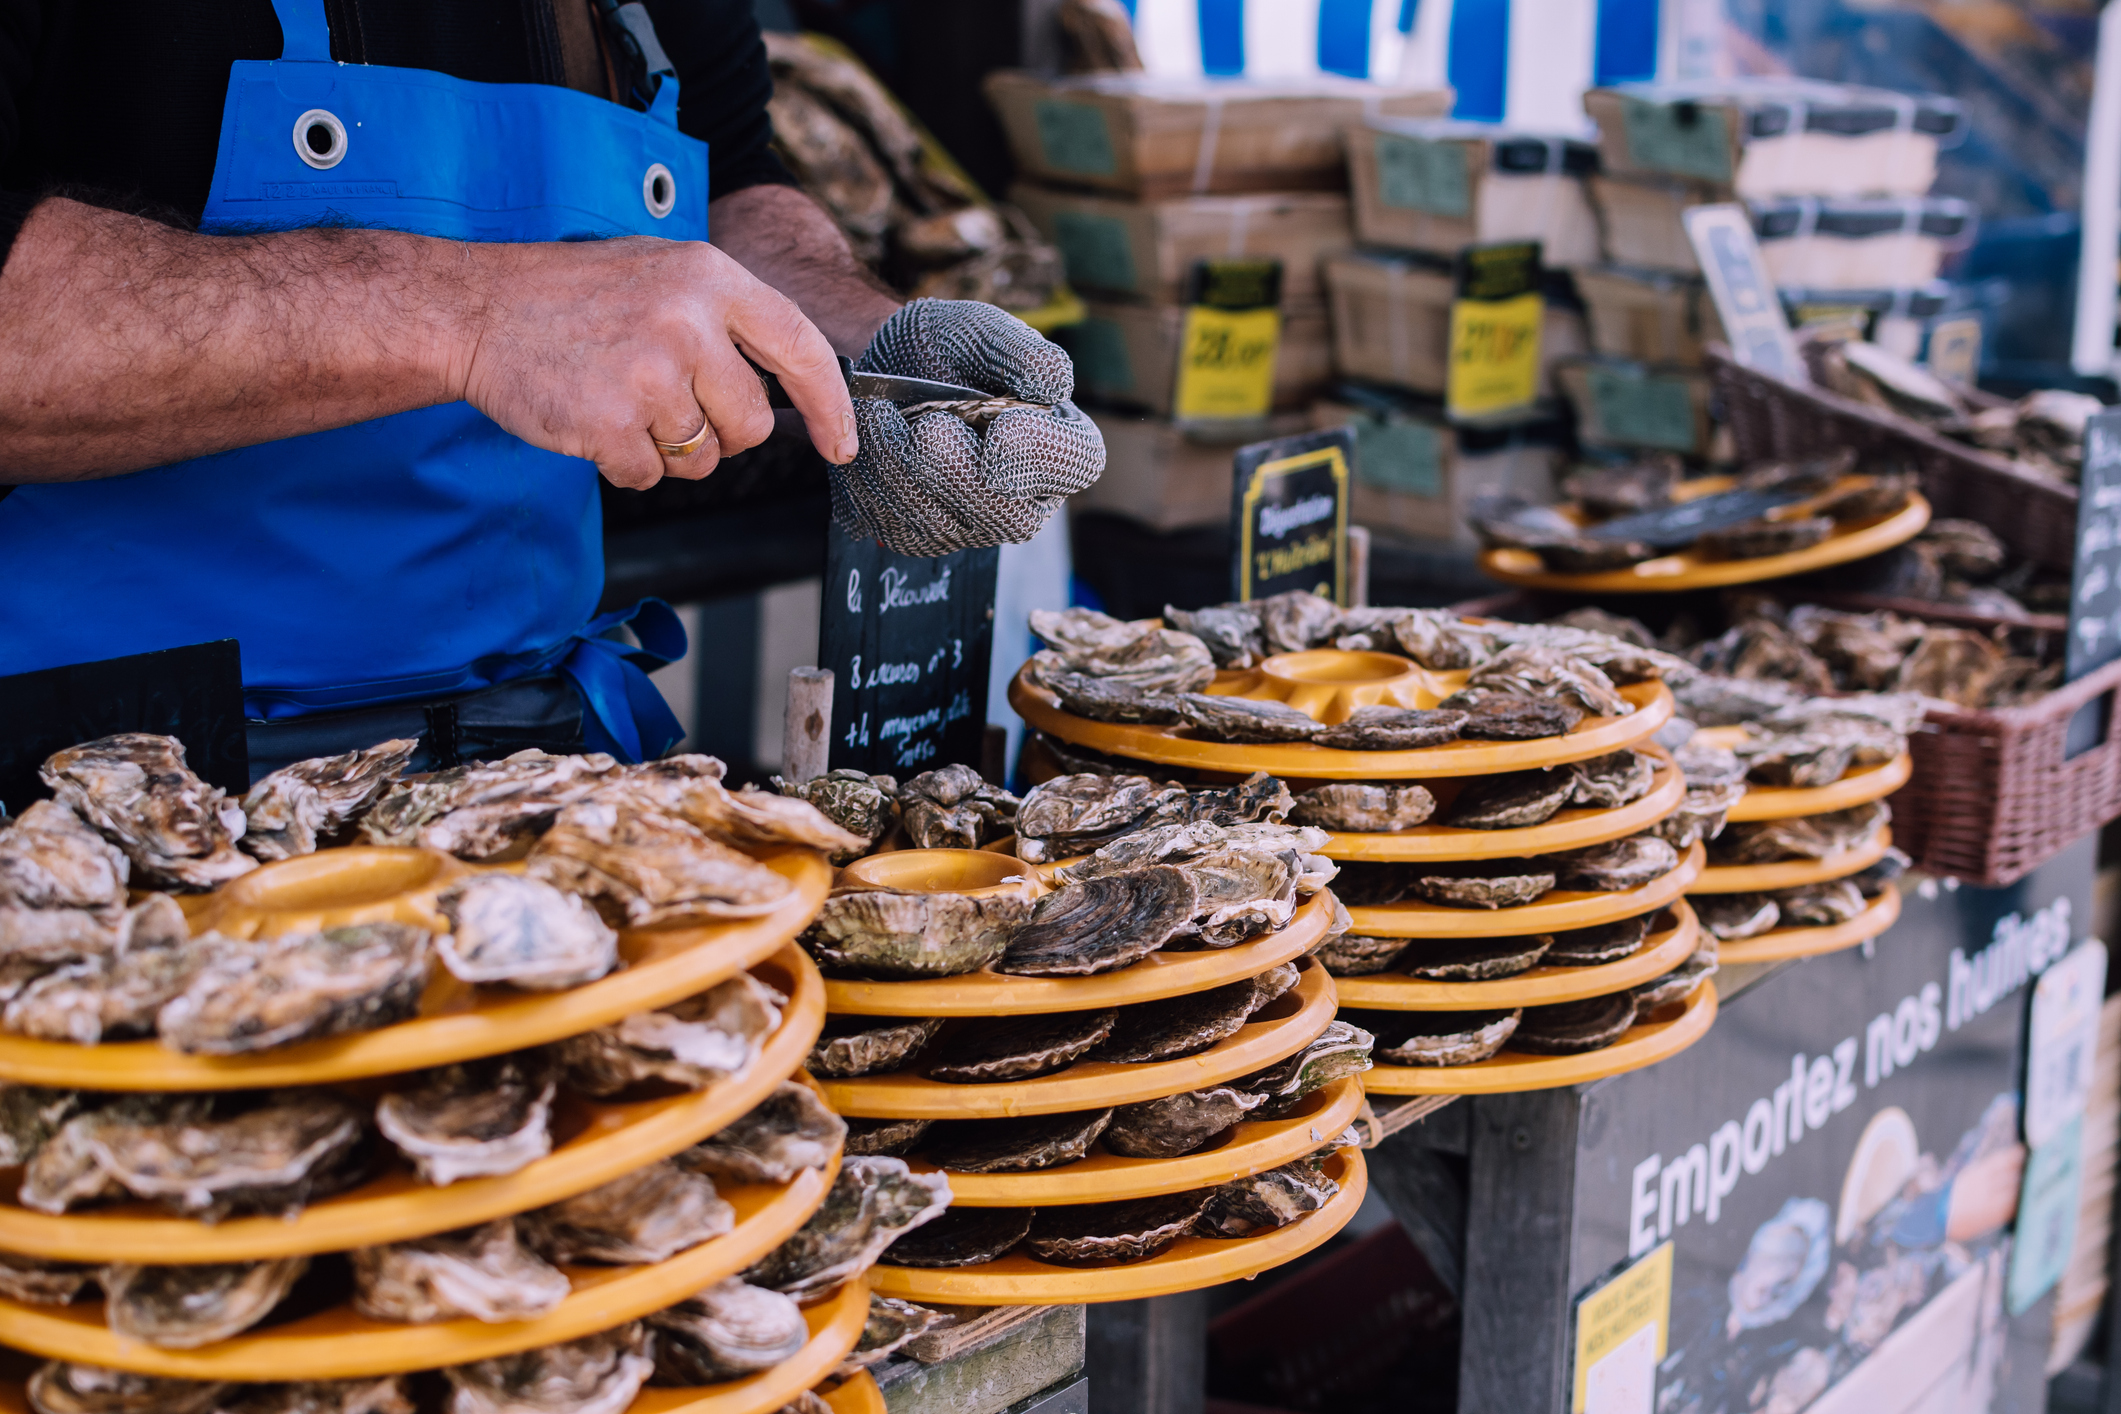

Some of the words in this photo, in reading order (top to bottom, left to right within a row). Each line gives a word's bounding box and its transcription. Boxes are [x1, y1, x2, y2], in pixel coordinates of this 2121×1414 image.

[357, 183, 396, 195] FRANCE
[851, 655, 862, 689] 8
[952, 638, 962, 669] 3
[1629, 1036, 1858, 1257] Emportez
[1864, 981, 1942, 1088] nos
